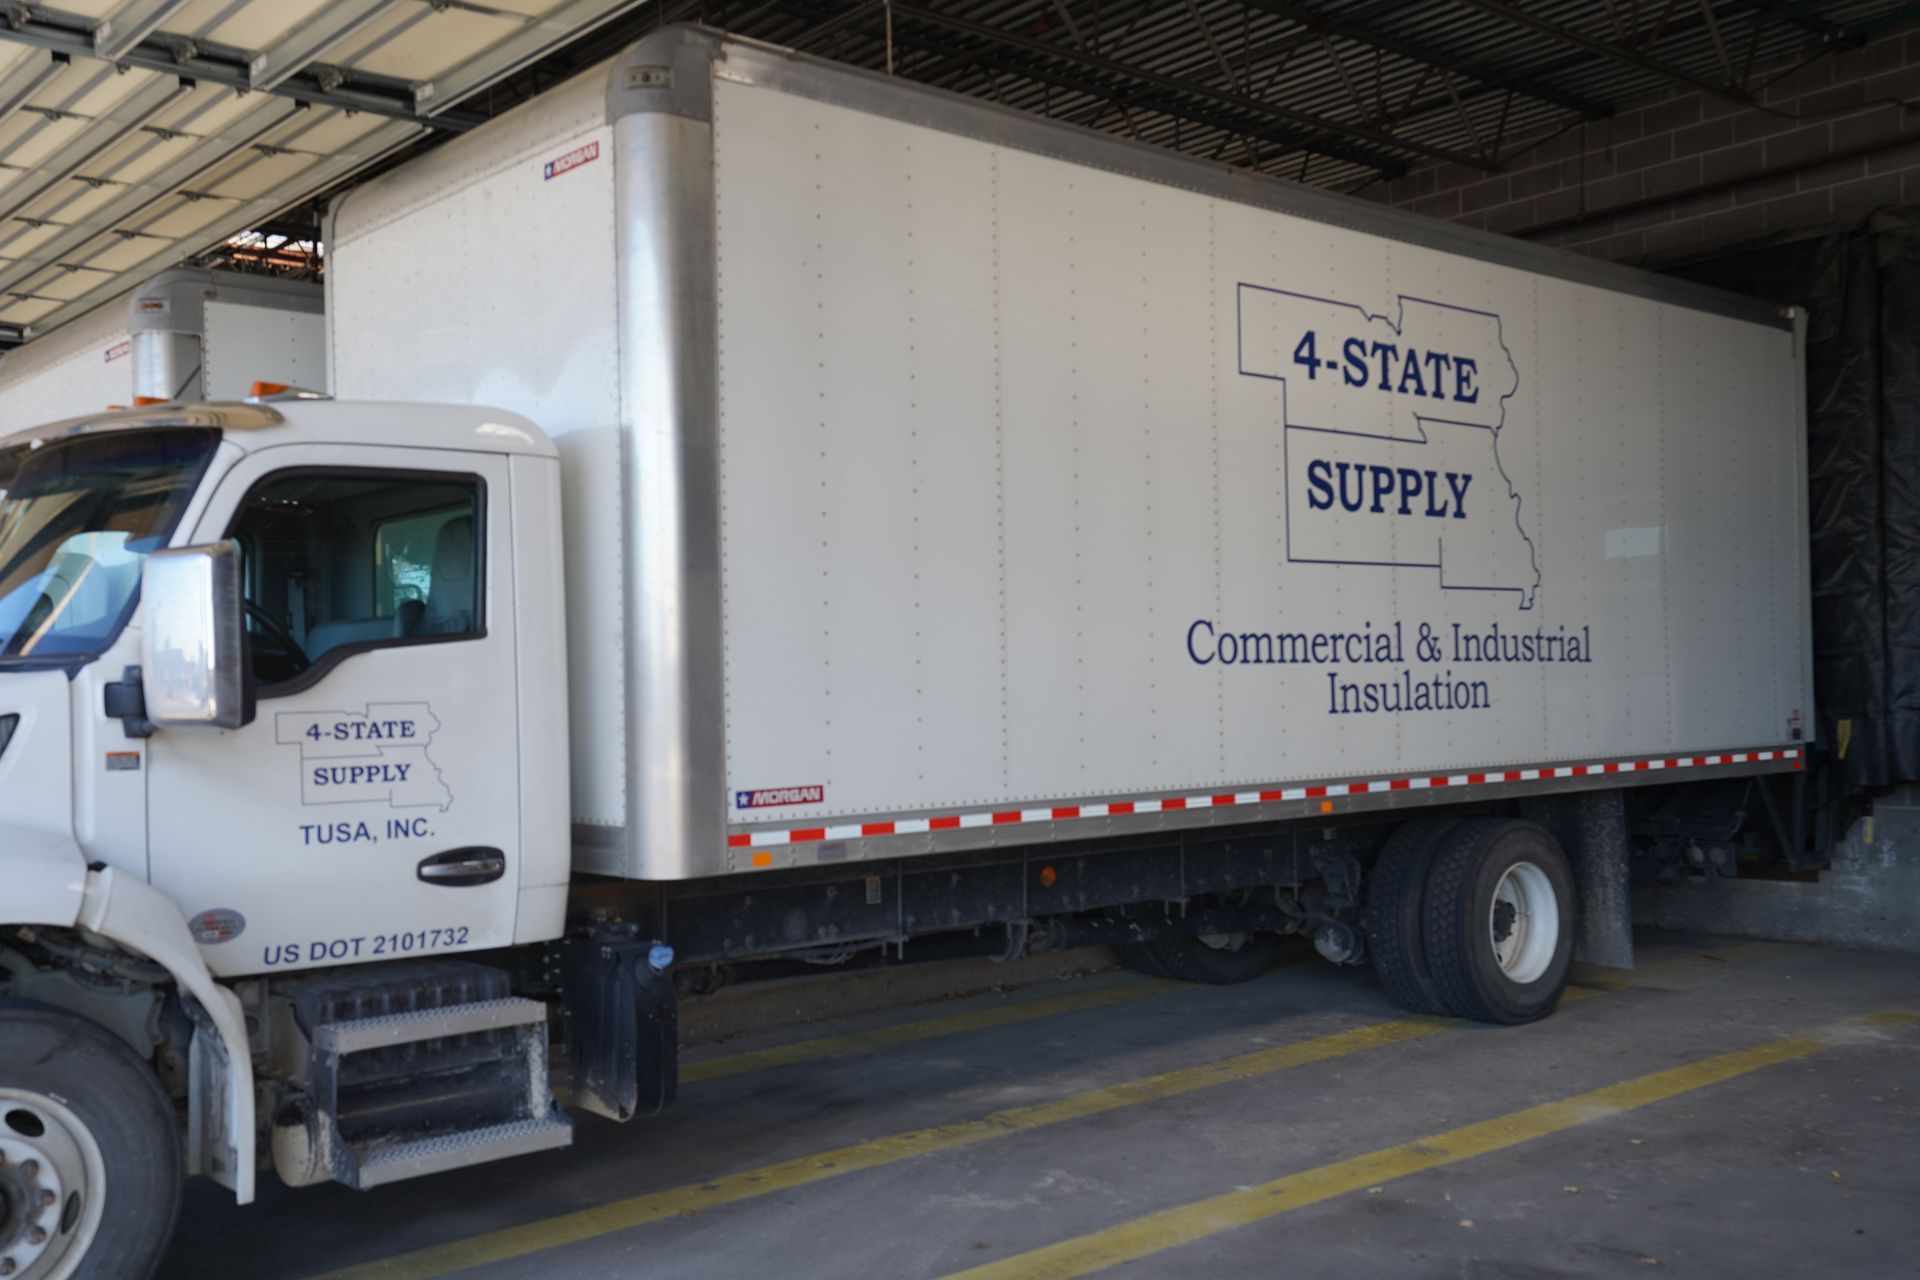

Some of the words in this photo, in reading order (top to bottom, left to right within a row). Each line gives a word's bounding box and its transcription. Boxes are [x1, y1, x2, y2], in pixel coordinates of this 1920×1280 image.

[1293, 330, 1479, 404] 4-STATE
[1307, 459, 1472, 519] SUPPLY
[1187, 619, 1404, 665] Commercial
[1416, 622, 1442, 663] &
[1452, 623, 1592, 663] Industrial
[1328, 669, 1491, 714] Insulation
[306, 720, 416, 741] 4-STATE
[313, 763, 411, 786] SUPPLY
[752, 788, 820, 805] MORGAN
[299, 821, 378, 845] TUSA,
[386, 817, 435, 839] INC.
[264, 944, 299, 965] US
[310, 937, 365, 961] DOT
[373, 926, 469, 954] 2101732
